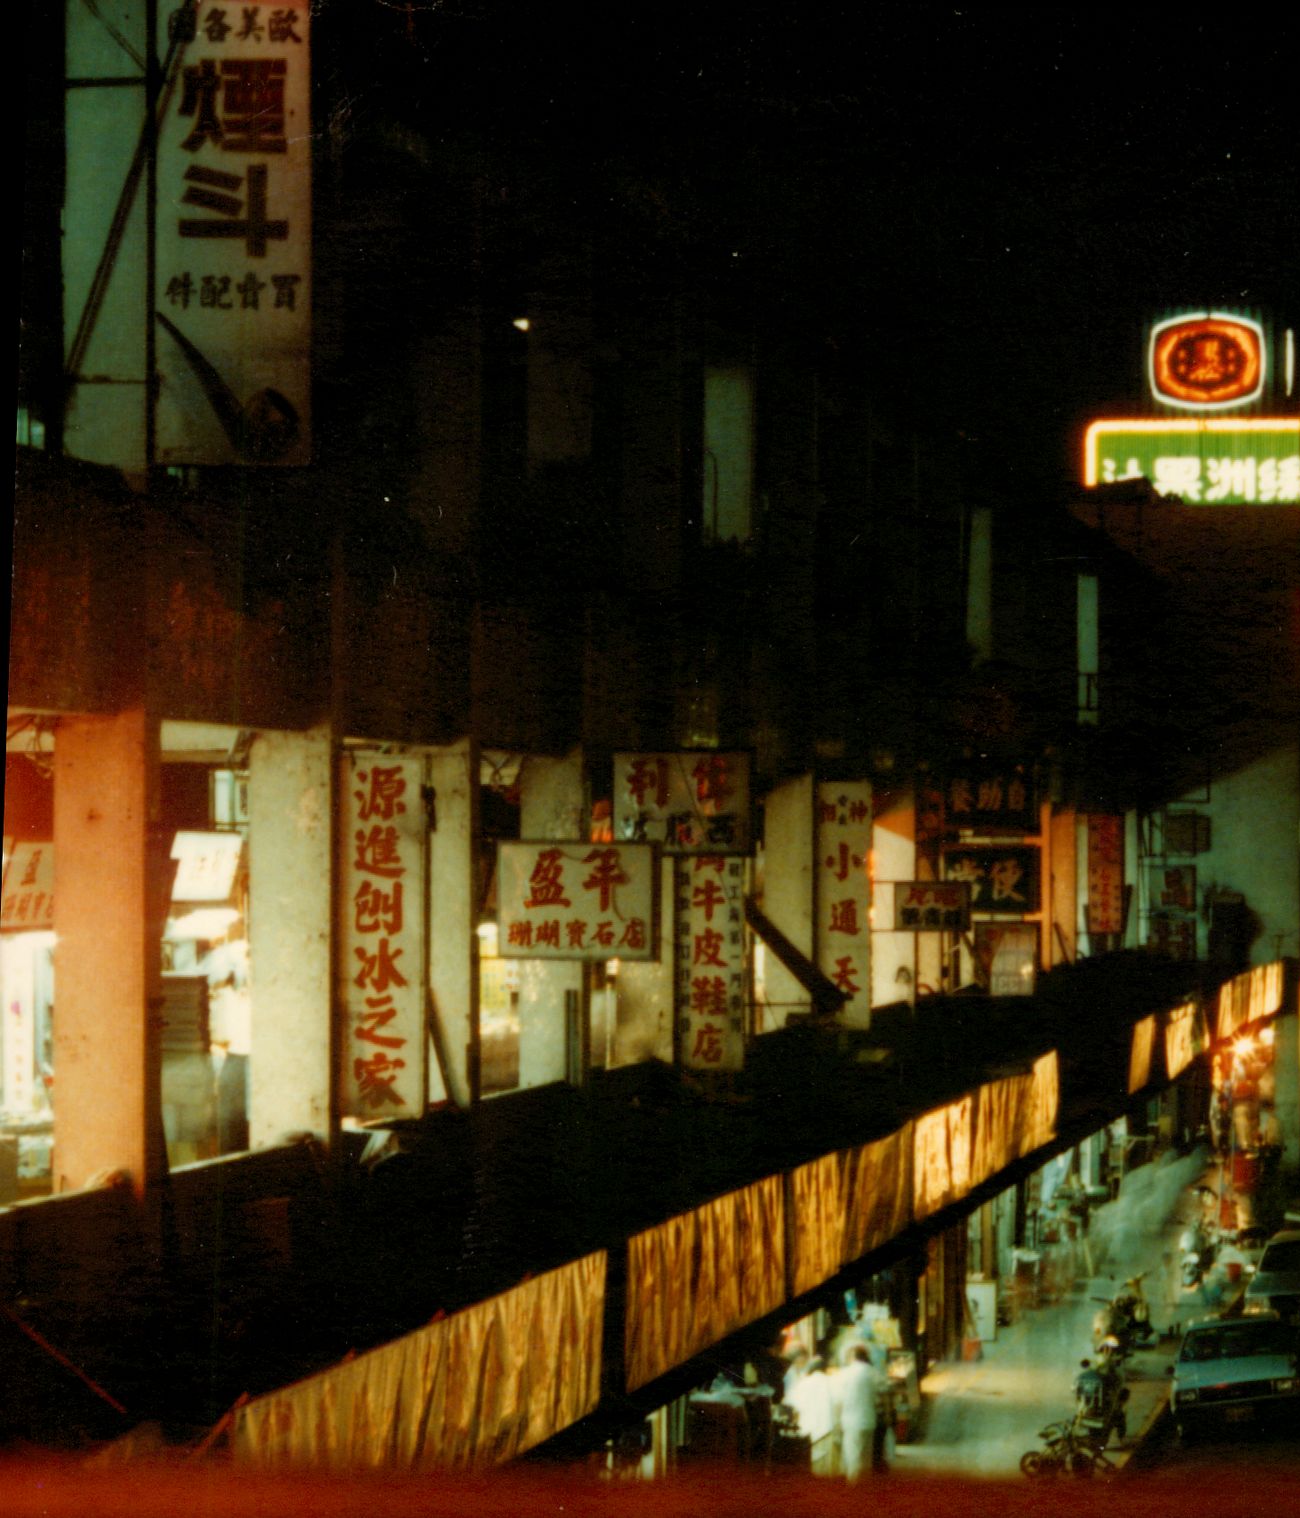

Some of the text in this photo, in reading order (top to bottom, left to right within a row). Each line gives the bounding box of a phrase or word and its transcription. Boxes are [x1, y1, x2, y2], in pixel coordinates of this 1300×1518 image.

[178, 58, 289, 259] 煙斗
[165, 271, 302, 313] 買賣配件
[354, 766, 407, 1108] 源進刨冰之家
[826, 843, 862, 992] 小通天
